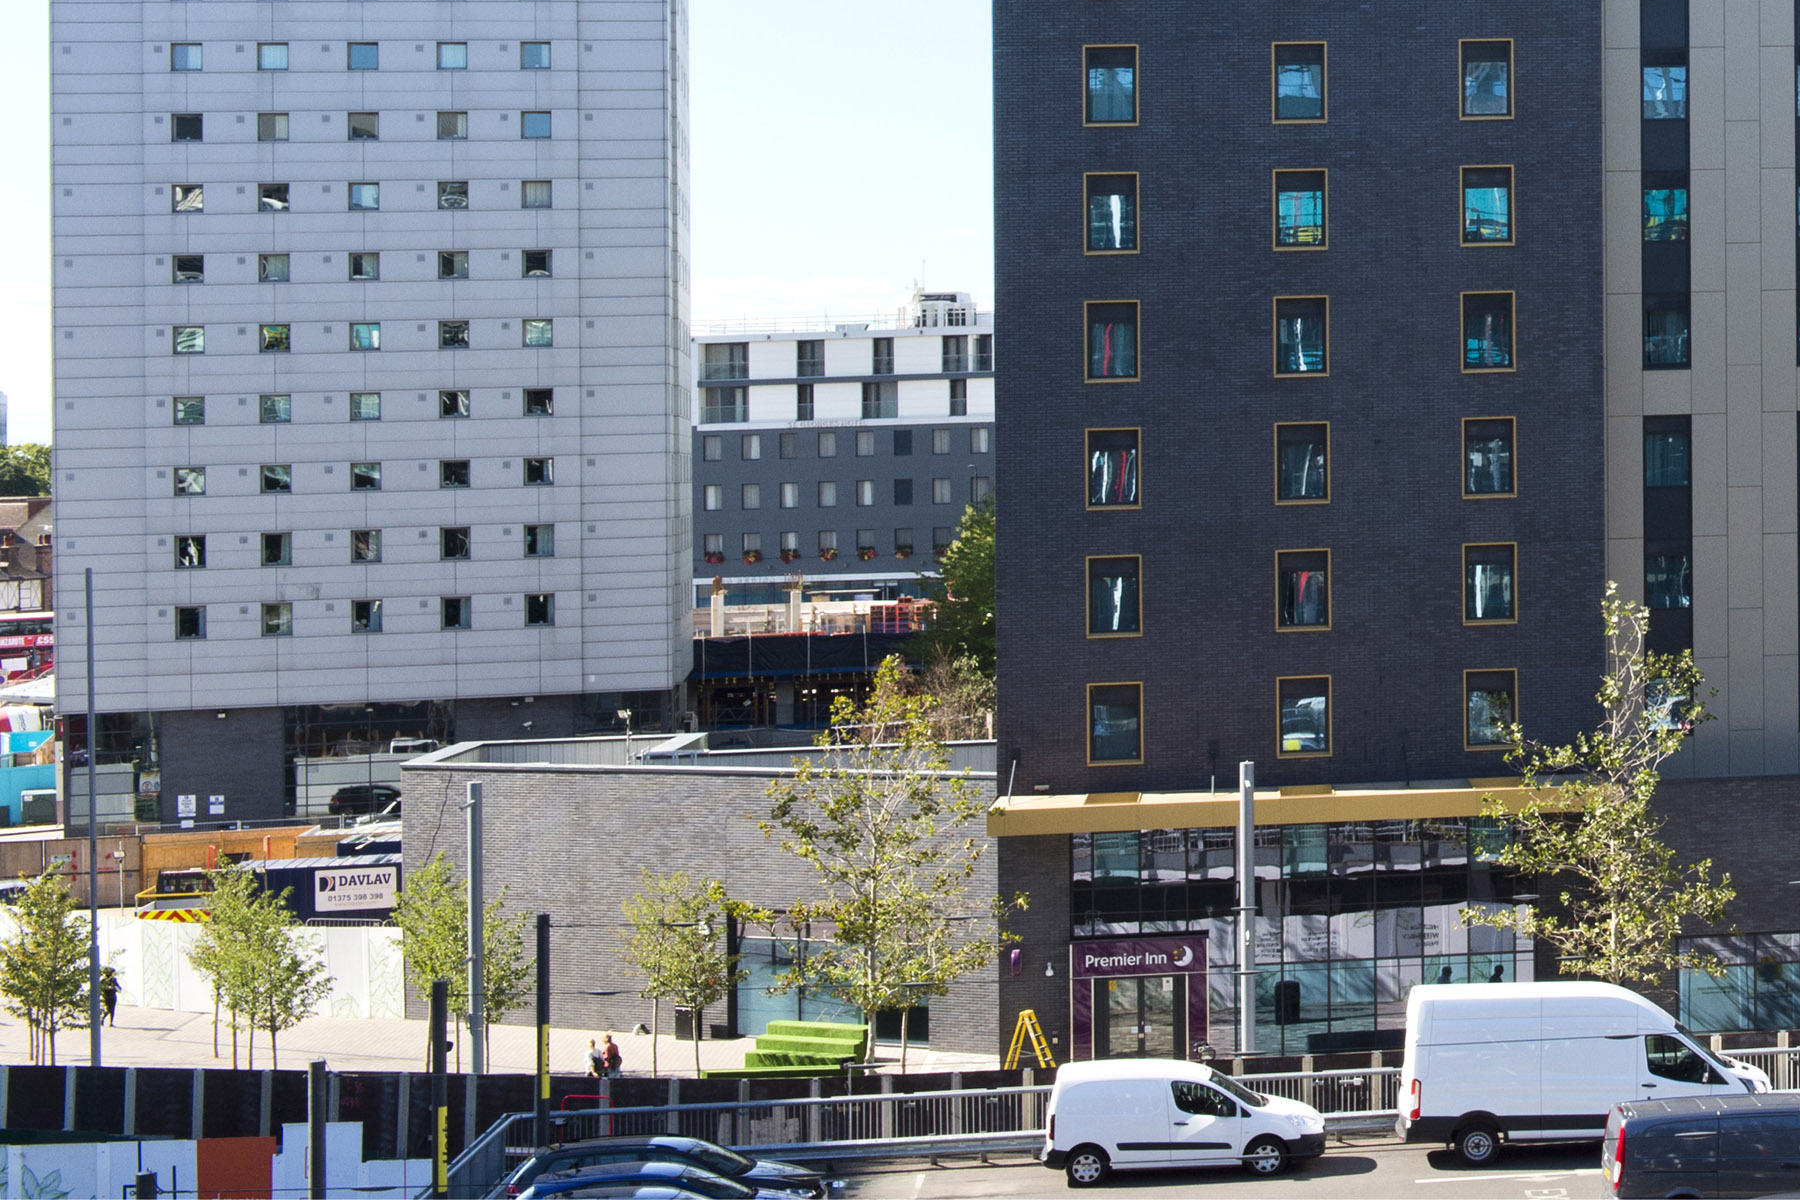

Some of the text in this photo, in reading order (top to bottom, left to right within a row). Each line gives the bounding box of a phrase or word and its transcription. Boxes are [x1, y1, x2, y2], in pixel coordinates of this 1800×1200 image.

[338, 873, 391, 887] DAVLAV
[1085, 952, 1168, 968] Premier Inn
